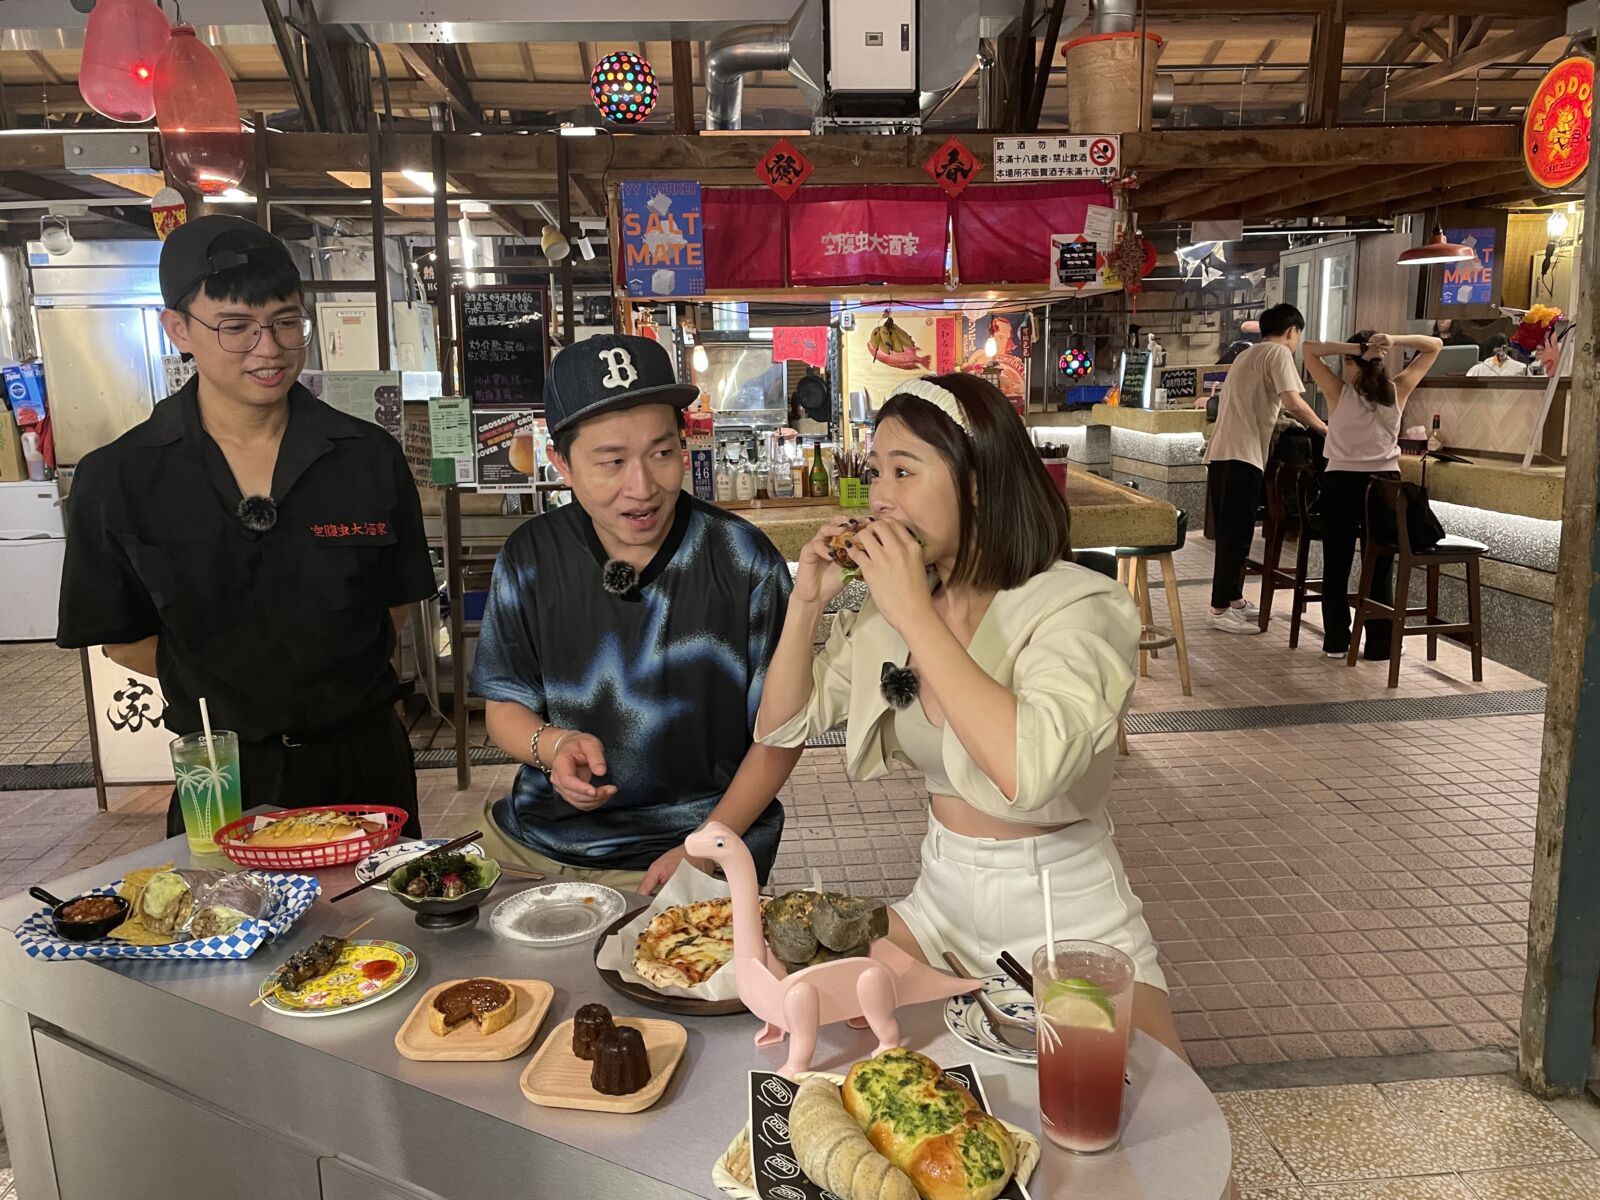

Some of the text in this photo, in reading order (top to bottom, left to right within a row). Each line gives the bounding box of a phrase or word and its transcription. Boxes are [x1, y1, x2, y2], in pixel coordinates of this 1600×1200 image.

[996, 139, 1087, 150] 飲酒勿開車
[935, 148, 973, 184] 春
[646, 183, 697, 195] MARKET
[624, 213, 700, 236] SALT
[626, 243, 702, 266] MATE
[1443, 267, 1491, 284] MATE
[599, 347, 639, 389] B
[478, 412, 520, 433] CROSSOVER
[695, 467, 710, 480] 46
[107, 677, 164, 733] 家
